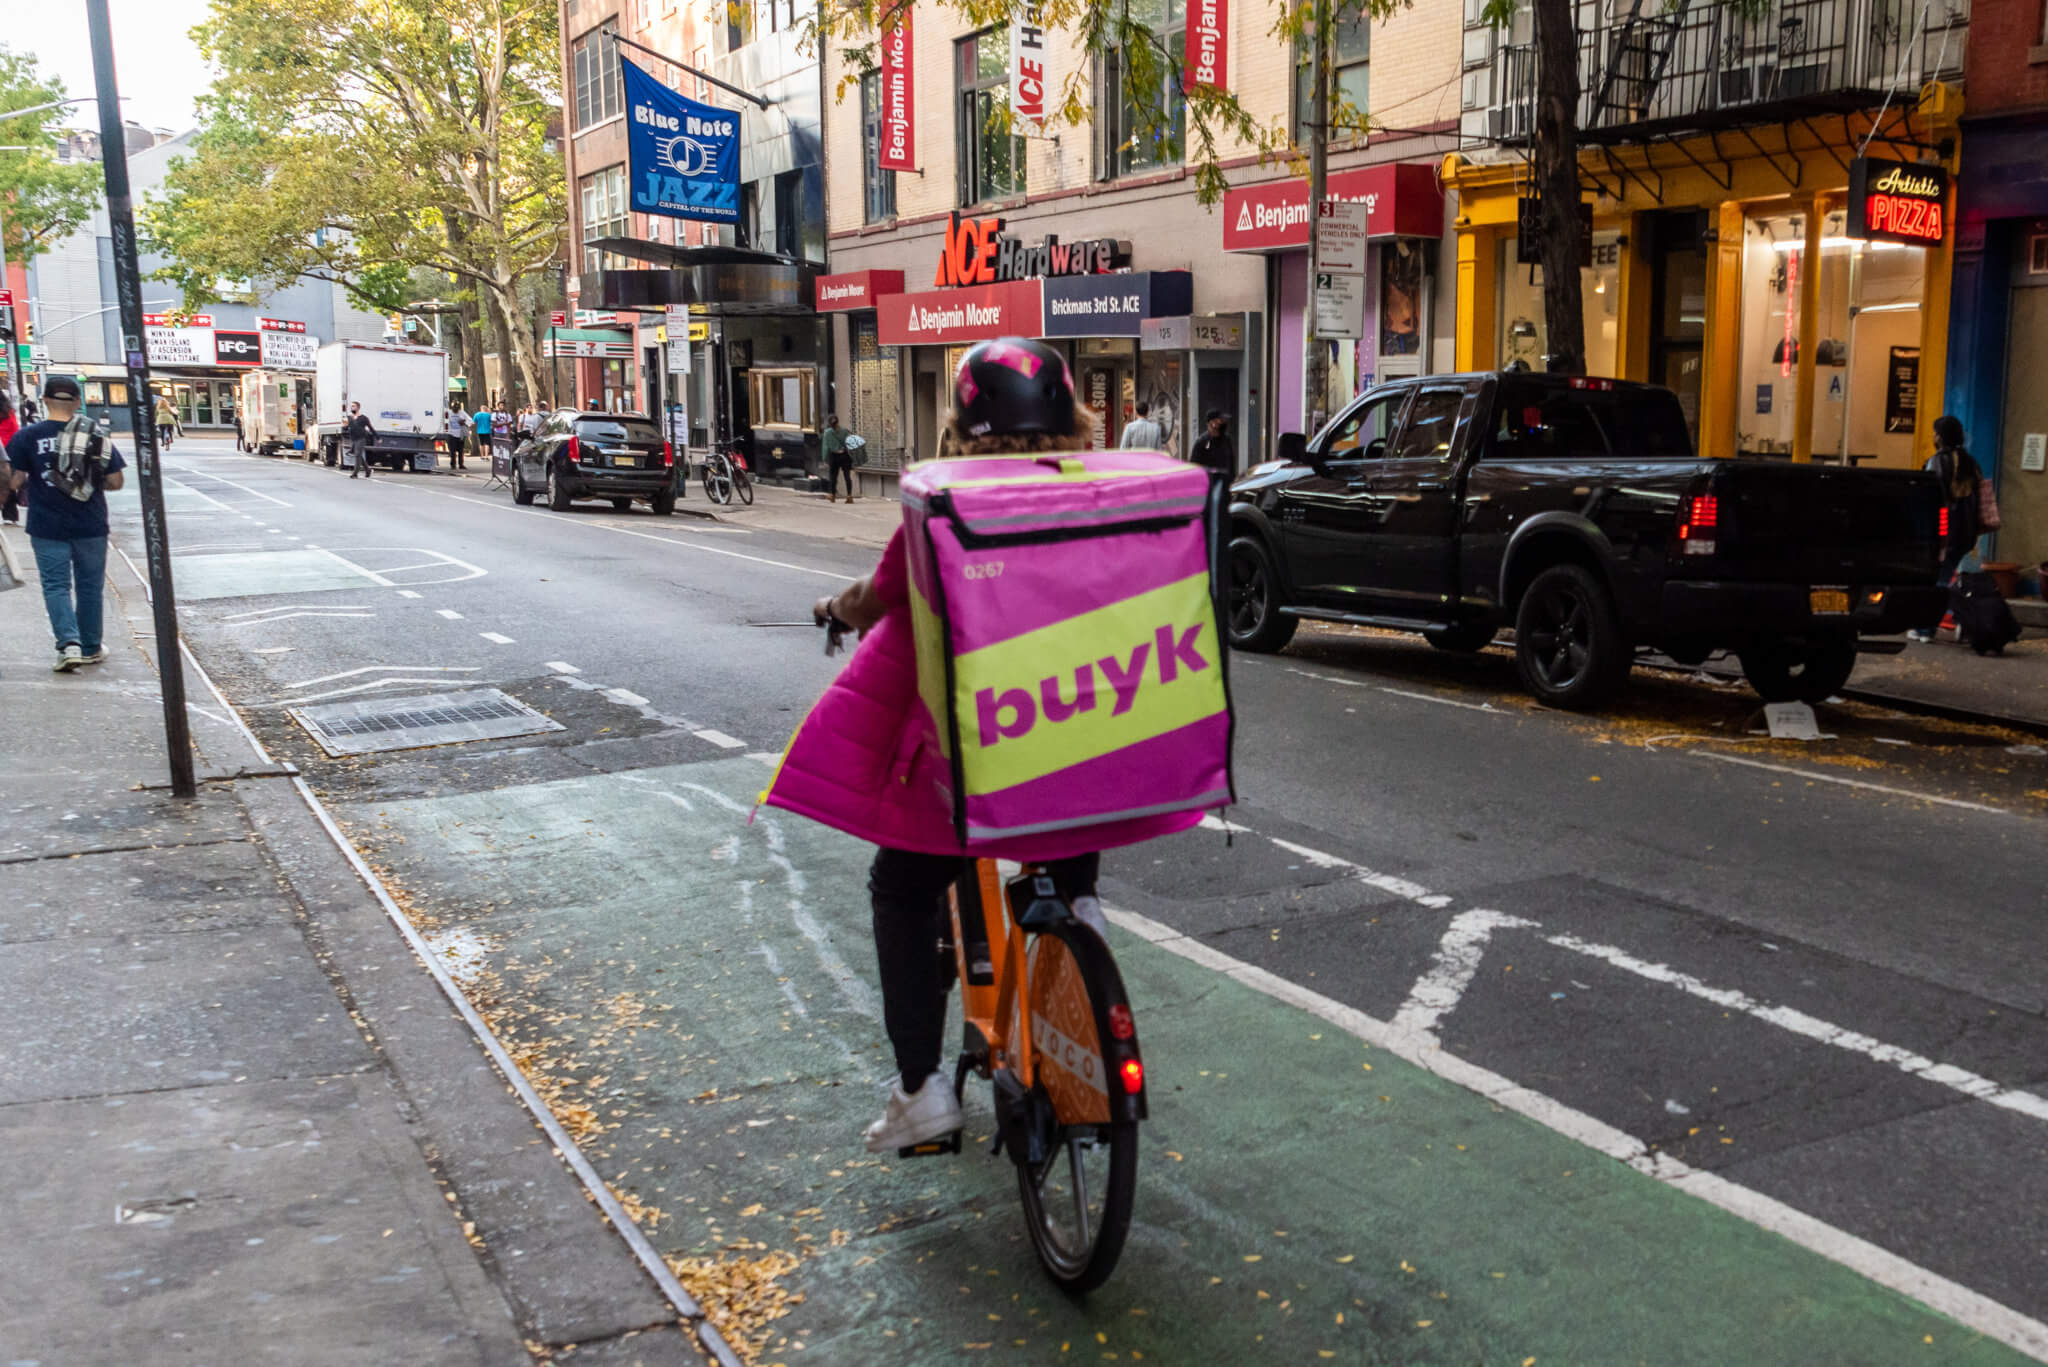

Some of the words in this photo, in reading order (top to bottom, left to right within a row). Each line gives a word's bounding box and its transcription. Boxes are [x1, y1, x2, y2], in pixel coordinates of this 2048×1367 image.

[1016, 56, 1043, 127] ACE
[634, 104, 680, 132] Blue
[686, 116, 733, 137] Note
[888, 73, 909, 160] Benjamin
[637, 171, 736, 209] JAZZ
[1876, 166, 1940, 197] Artistic
[658, 201, 689, 211] CAPITAL
[1321, 203, 1331, 217] 3
[1871, 193, 1942, 240] PIZZA
[934, 210, 999, 287] ACE
[1000, 234, 1113, 281] Hardware
[828, 284, 848, 300] Benjamin
[849, 284, 864, 296] Moore
[1319, 275, 1329, 289] 2
[921, 305, 964, 335] Benjamin
[966, 303, 1000, 326] Moore
[1052, 296, 1092, 315] Brickmans
[1093, 296, 1108, 313] 3rd
[1110, 297, 1121, 313] St.
[1123, 296, 1140, 313] ACE
[1196, 326, 1218, 339] 125
[1091, 373, 1106, 408] SONS
[1830, 375, 1841, 394] A
[963, 561, 1004, 580] 0267
[975, 622, 1211, 748] buyk
